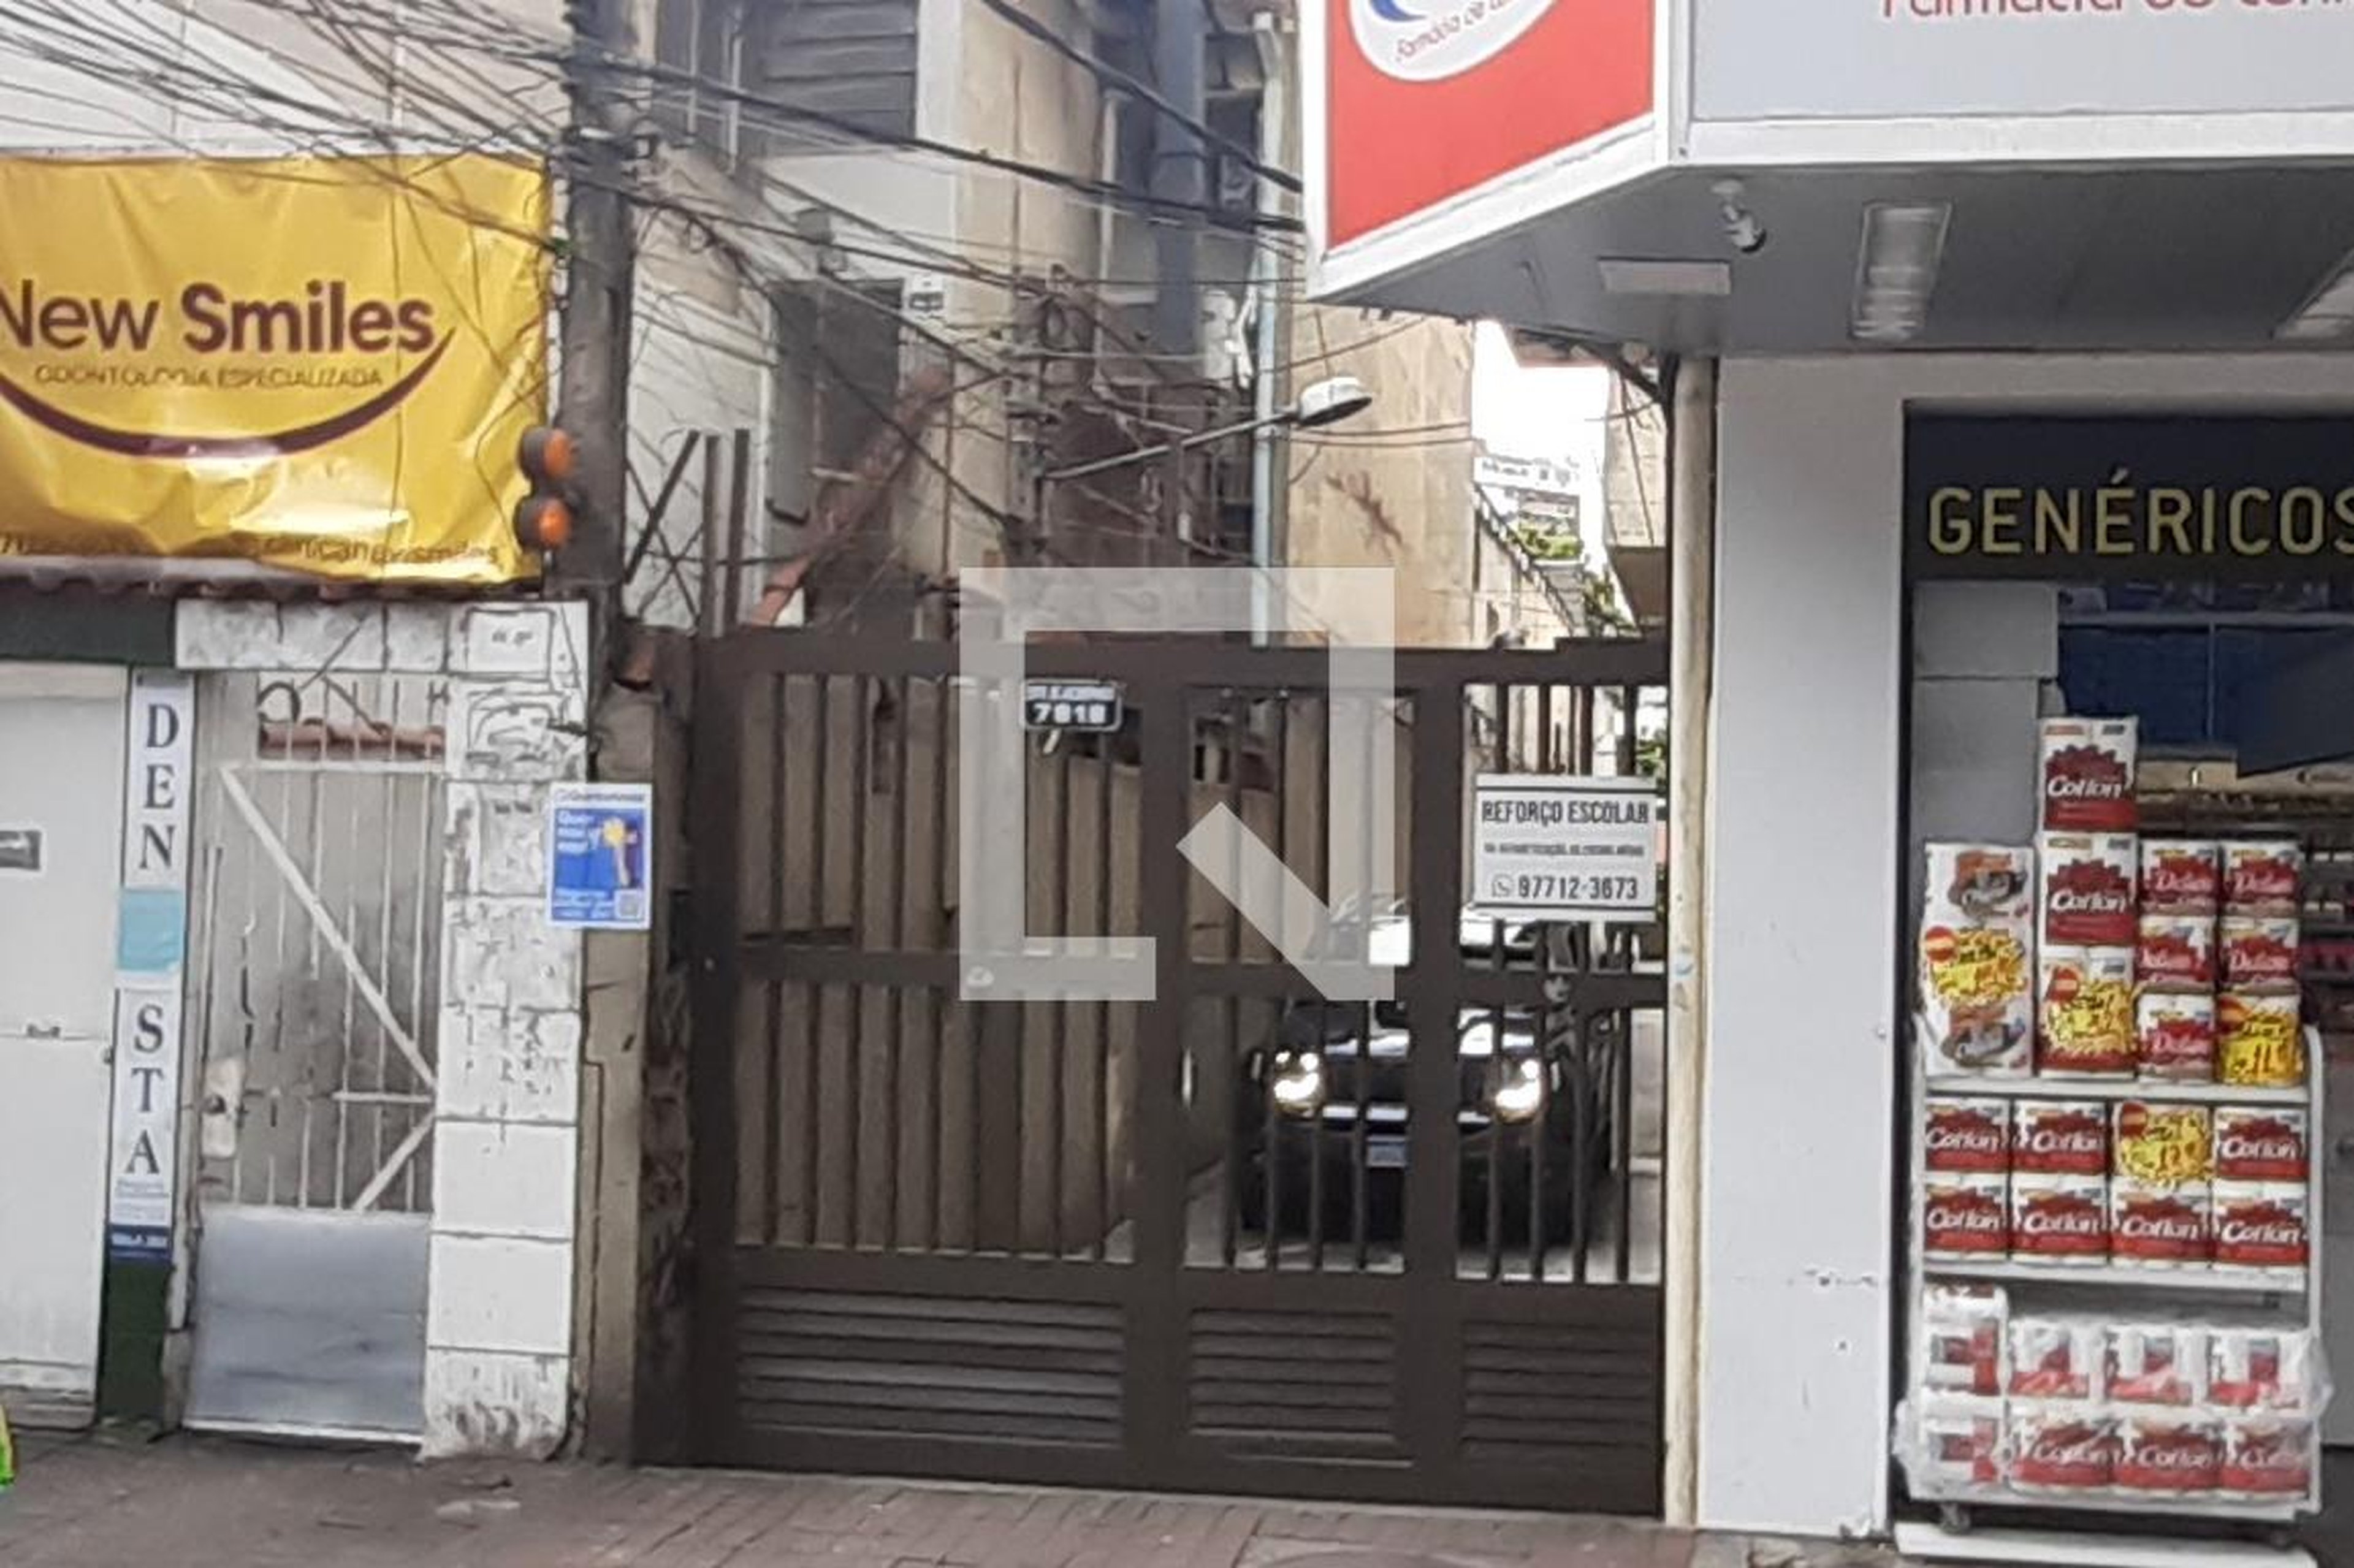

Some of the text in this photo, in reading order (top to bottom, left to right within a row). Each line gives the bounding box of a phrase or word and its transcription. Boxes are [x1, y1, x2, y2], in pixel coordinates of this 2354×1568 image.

[0, 279, 435, 353] New Smiles
[1481, 800, 1649, 827] REFORÇO ESCOLAR
